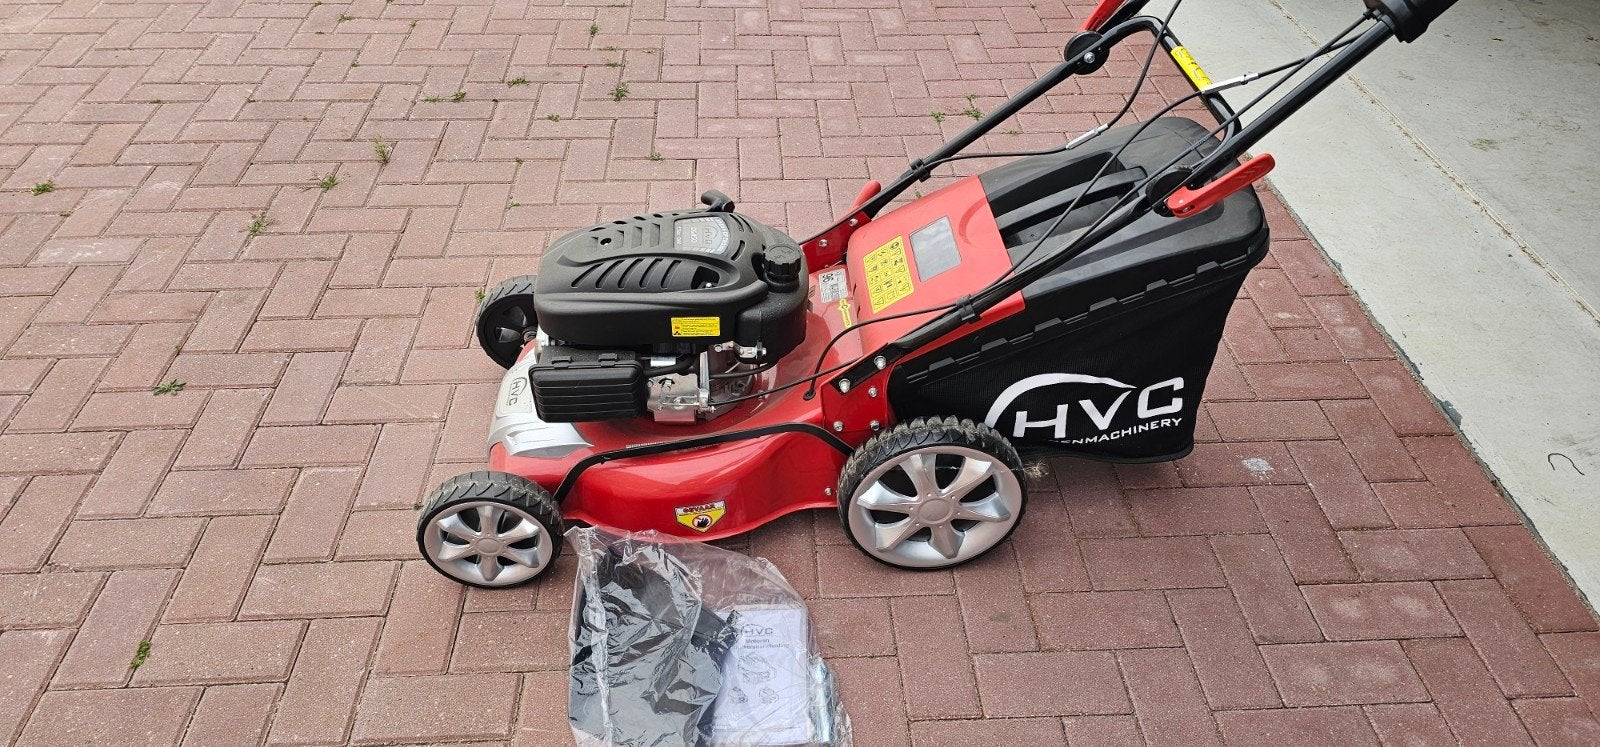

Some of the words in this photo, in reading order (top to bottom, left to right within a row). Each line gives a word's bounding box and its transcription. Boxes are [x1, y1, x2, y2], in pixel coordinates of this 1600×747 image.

[509, 380, 522, 406] HVC
[1012, 376, 1185, 439] HVC
[744, 627, 773, 635] HVC
